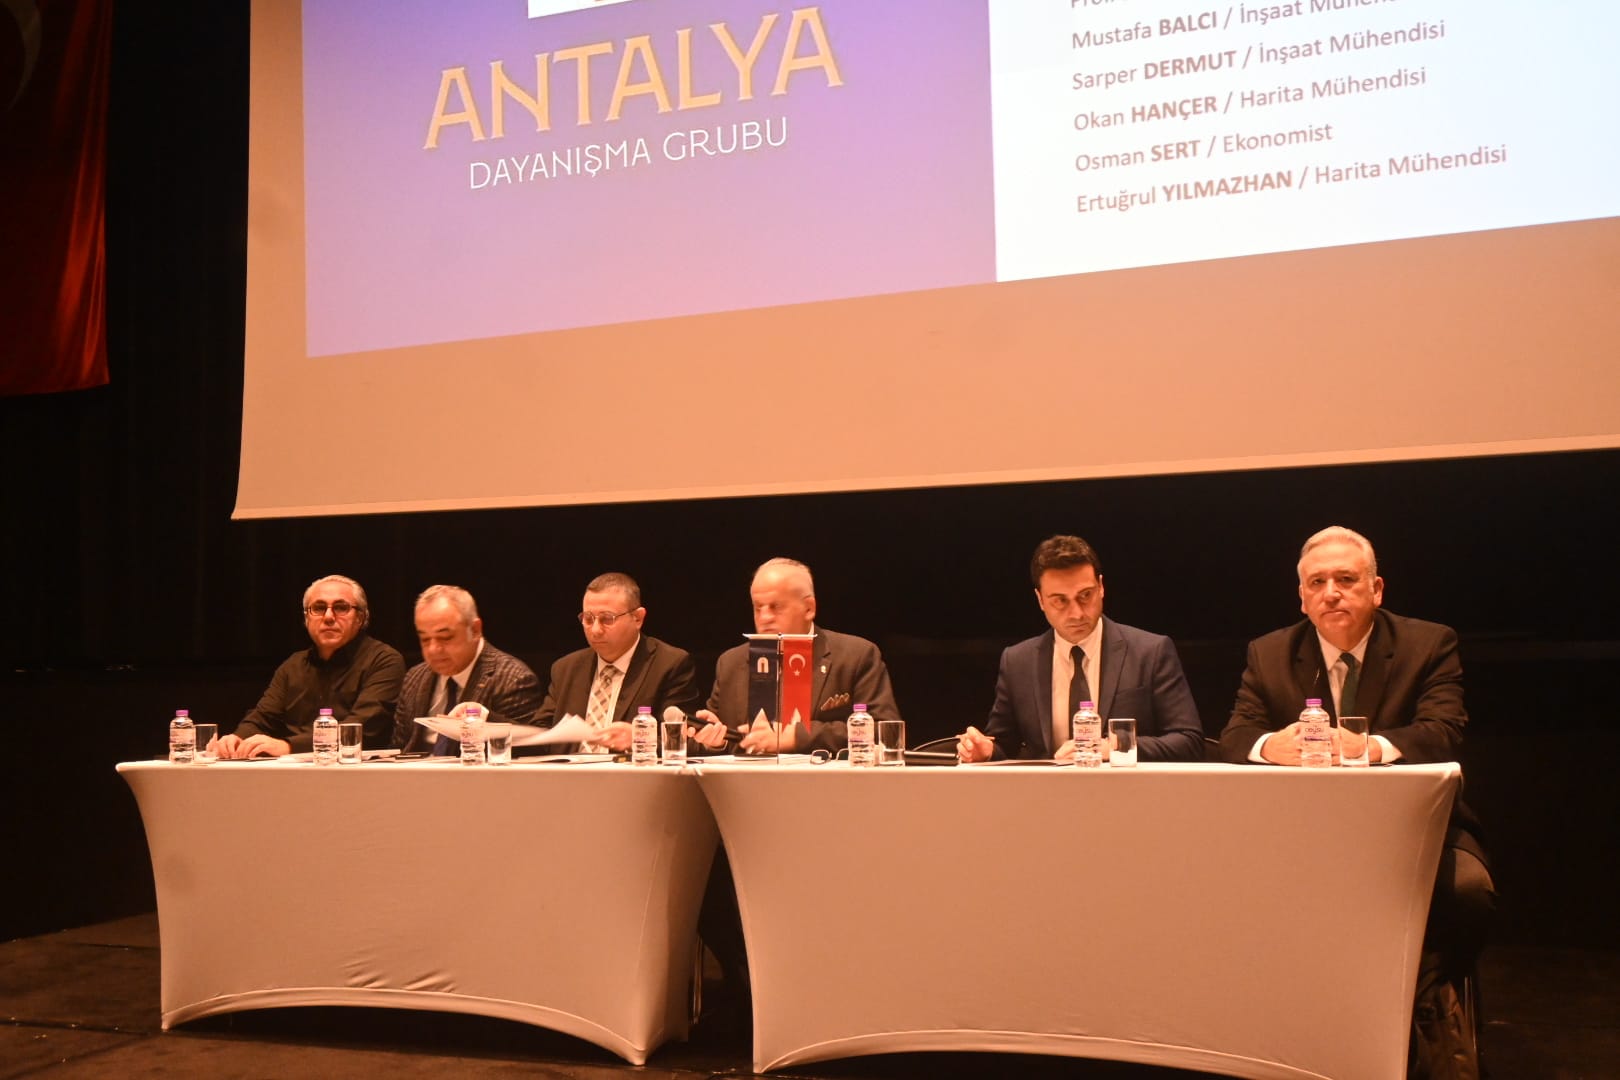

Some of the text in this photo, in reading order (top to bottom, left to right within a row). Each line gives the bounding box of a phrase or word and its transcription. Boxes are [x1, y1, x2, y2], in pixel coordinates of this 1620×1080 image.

[1071, 22, 1152, 49] Mustafa
[1158, 11, 1218, 37] BALCI
[1223, 6, 1233, 31] /
[1239, 0, 1304, 25] İnşaat
[1072, 20, 1445, 91] Sarper DERMUT / İnşaat Mühendisi
[424, 7, 844, 151] ANTALYA
[1073, 67, 1427, 131] Okan HANÇER / Harita Mühendisi
[470, 117, 787, 190] DAYANIŞMA GRUBU
[1075, 123, 1333, 172] Osman SERT / Ekonomist
[1076, 144, 1507, 213] Ertuğrul YILMAZHAN / Harita Mühendisi
